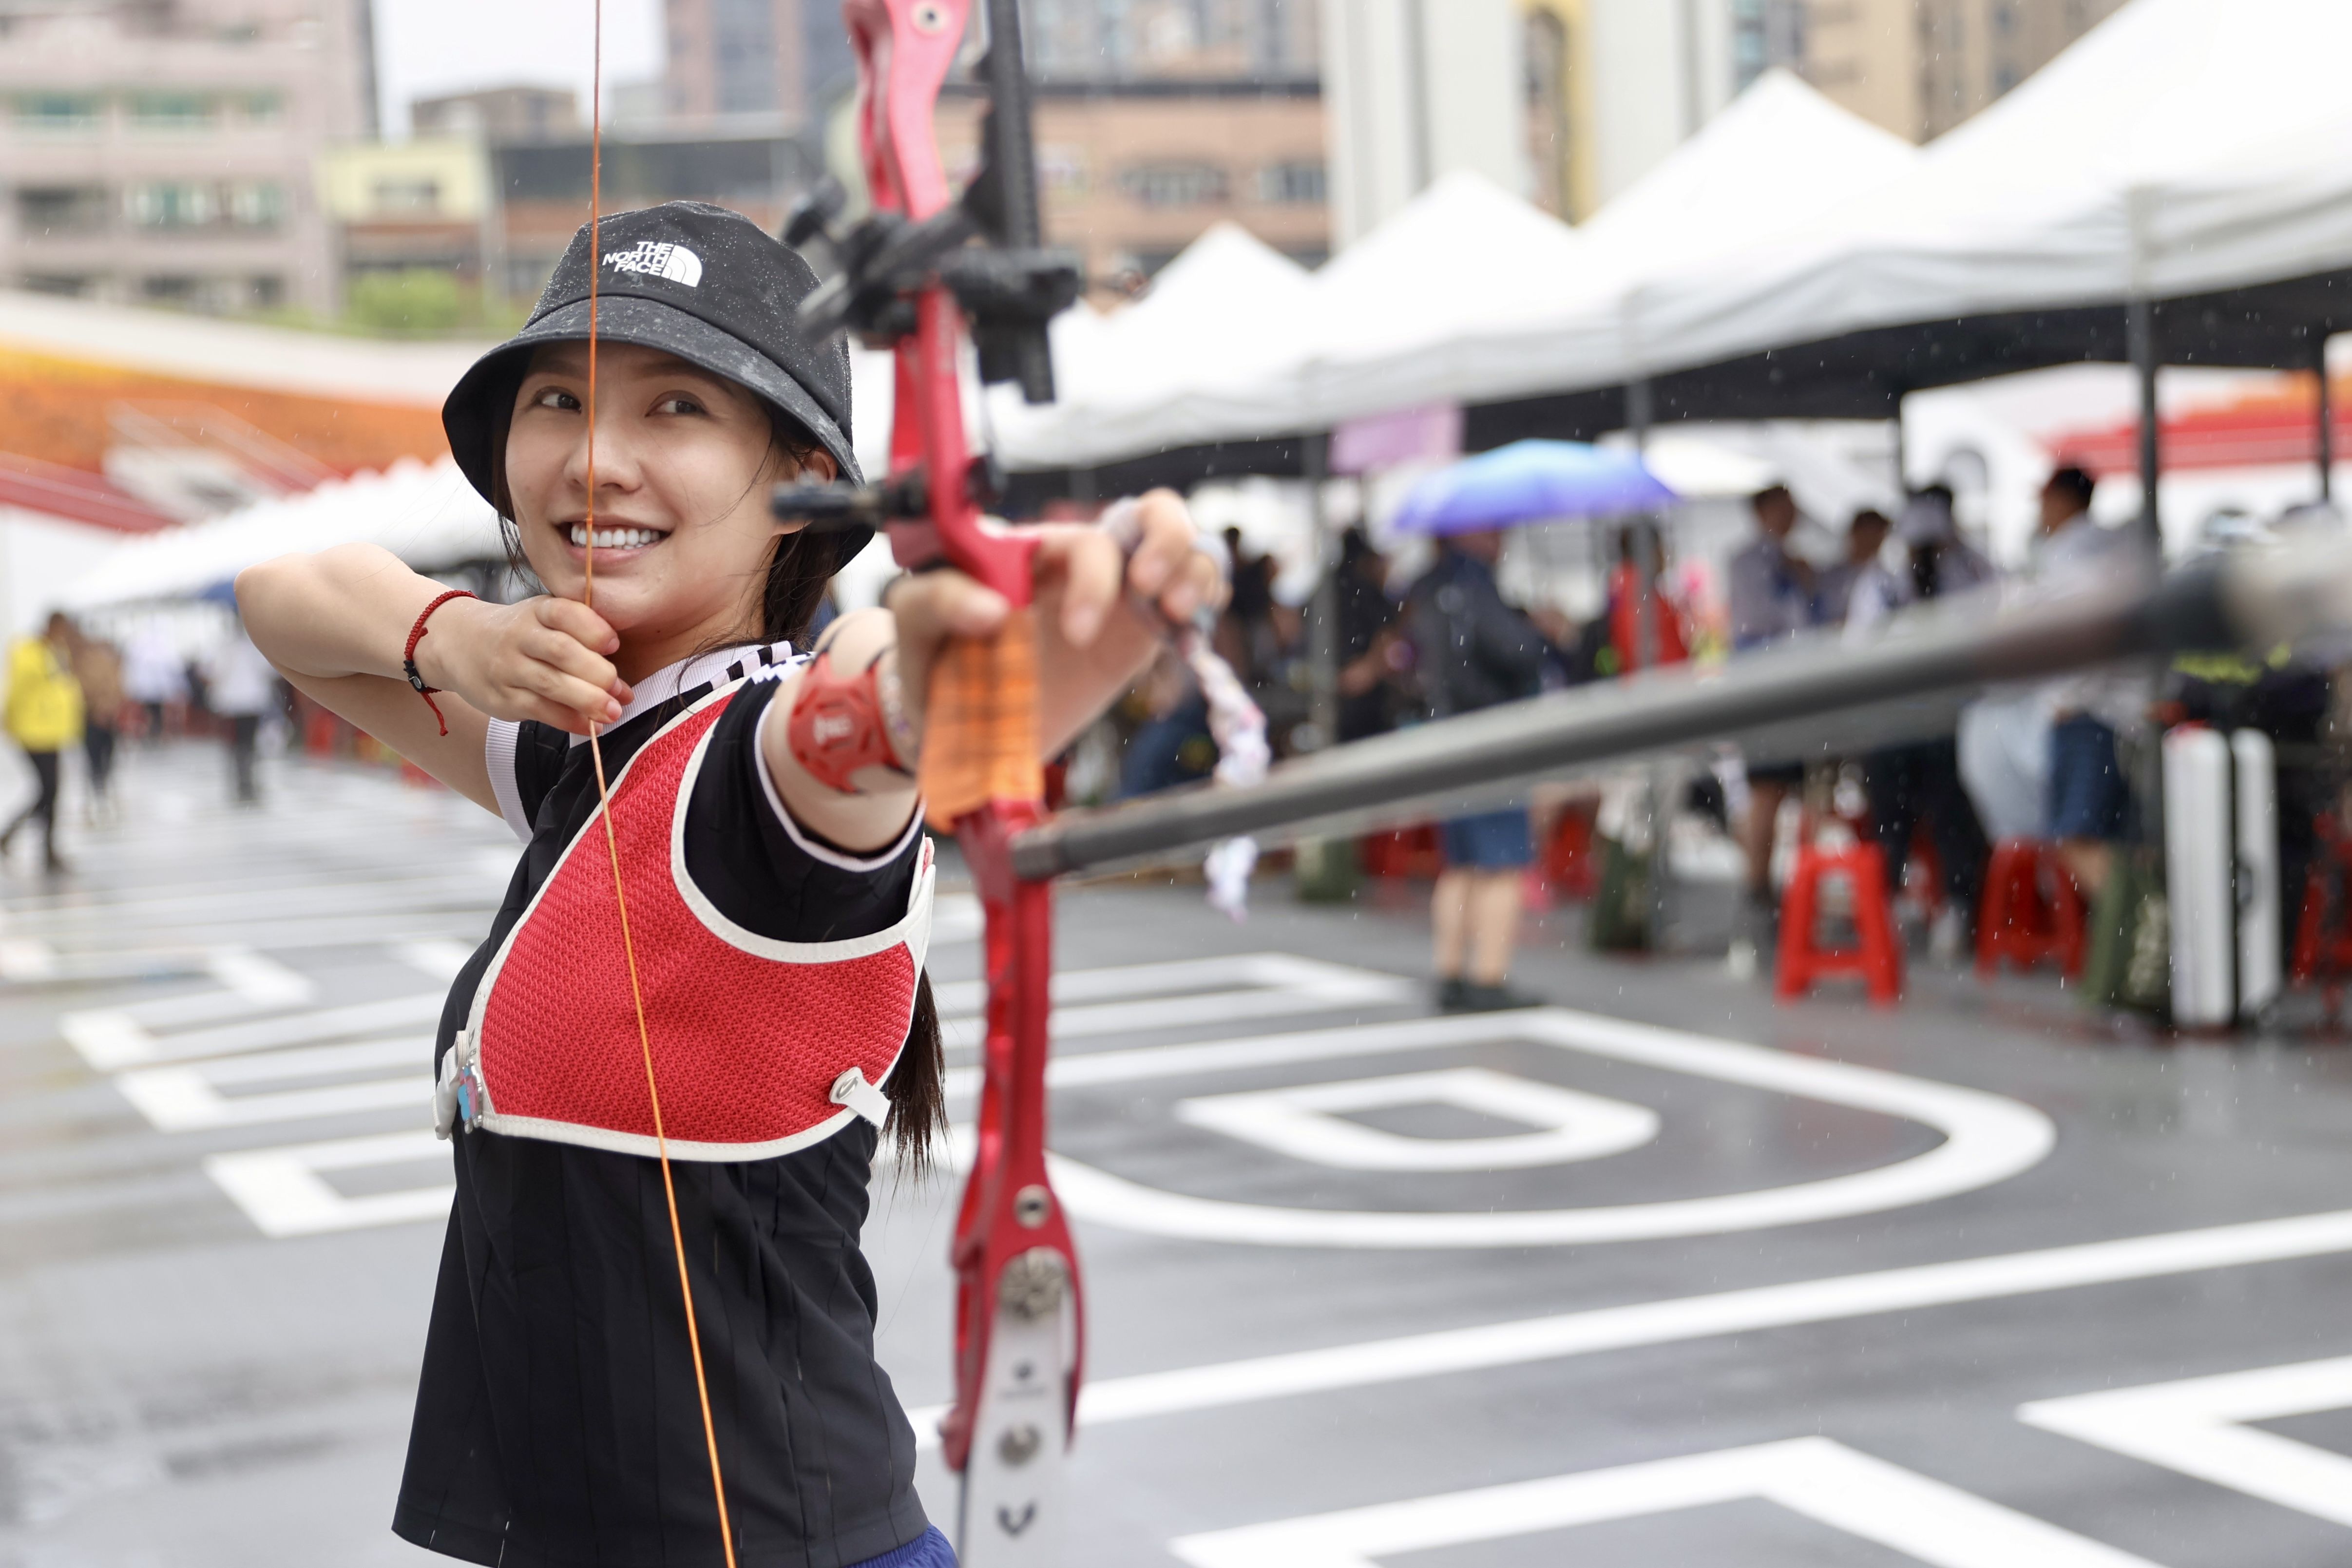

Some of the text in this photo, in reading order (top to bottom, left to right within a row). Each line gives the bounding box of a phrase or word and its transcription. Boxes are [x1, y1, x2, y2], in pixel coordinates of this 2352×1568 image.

[637, 241, 674, 253] THE
[602, 251, 670, 266] NORTH
[614, 261, 665, 276] FACE
